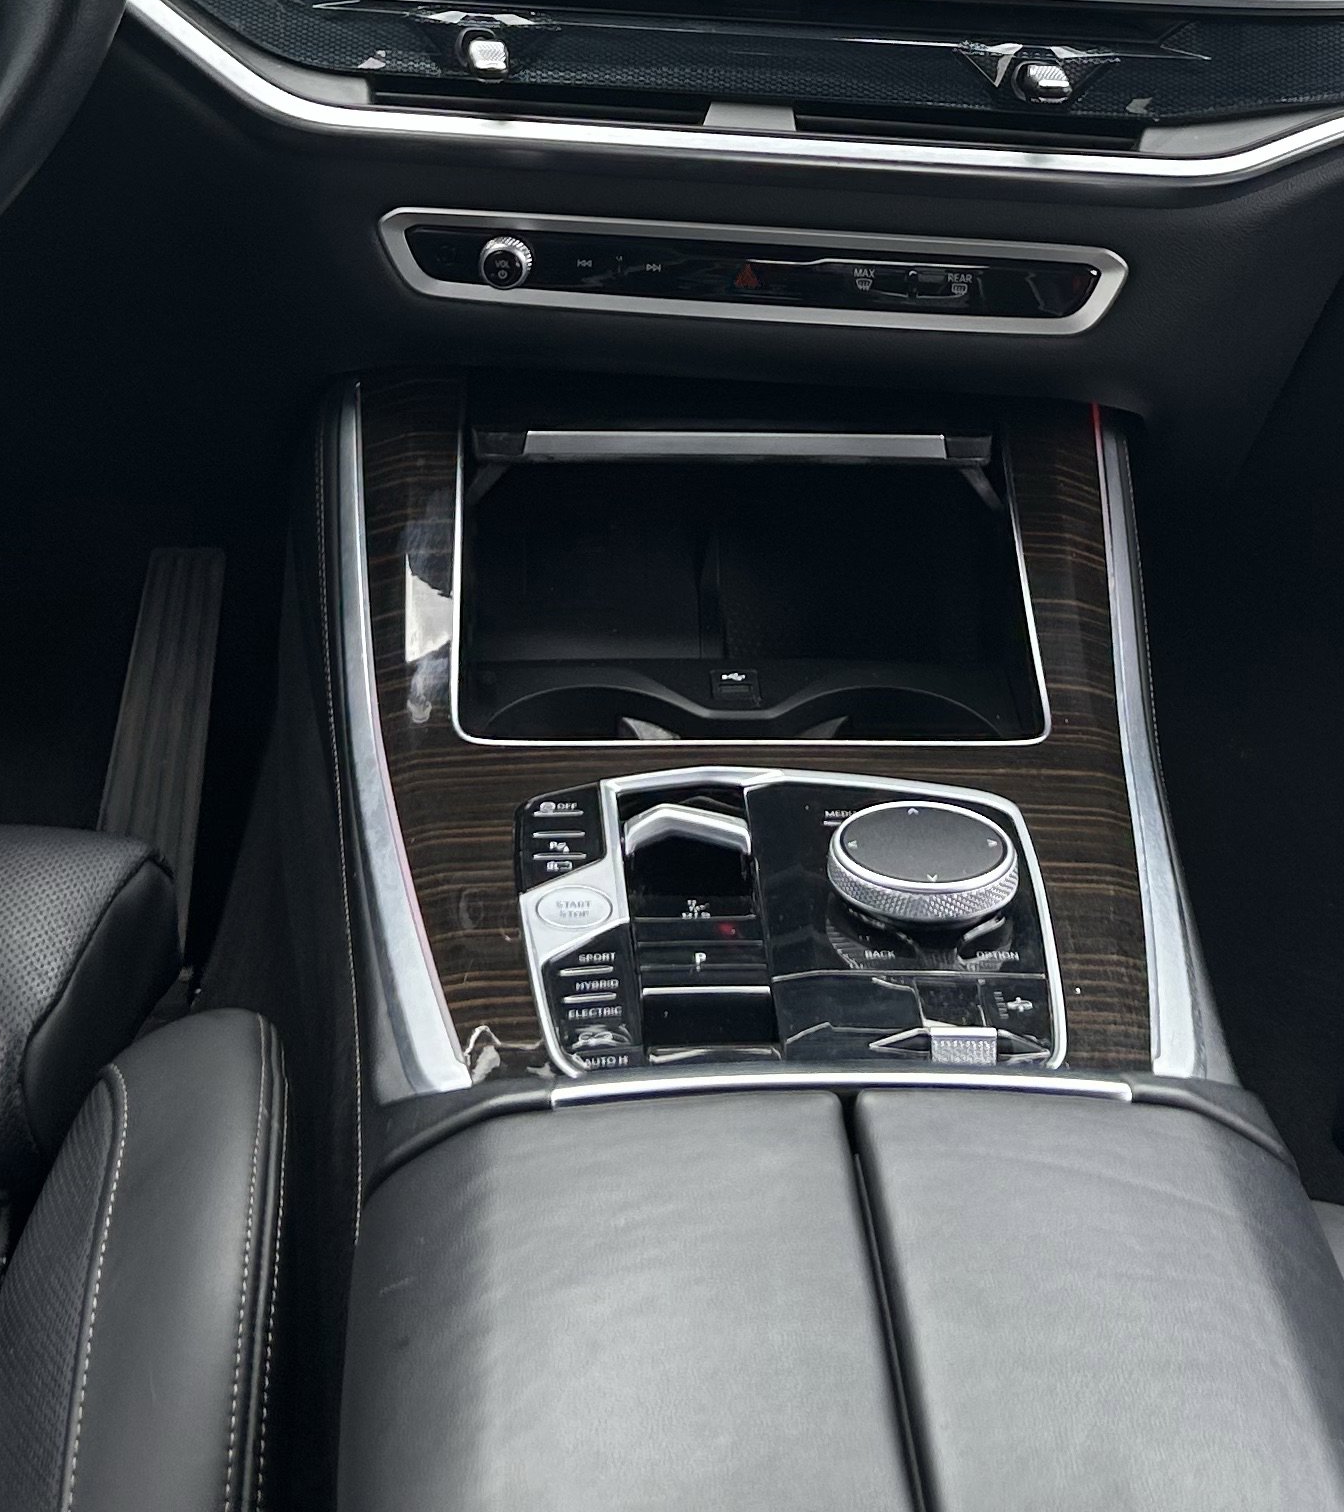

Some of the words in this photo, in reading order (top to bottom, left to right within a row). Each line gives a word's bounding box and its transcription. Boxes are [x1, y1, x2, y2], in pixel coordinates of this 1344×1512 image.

[853, 268, 876, 278] MAX
[947, 273, 973, 283] REAR
[557, 900, 592, 908] START
[578, 952, 616, 963] SPORT
[864, 949, 896, 960] BACK
[975, 950, 1020, 961] OPTION
[576, 979, 619, 990] HYBRID
[568, 1006, 623, 1020] ELECTRIC
